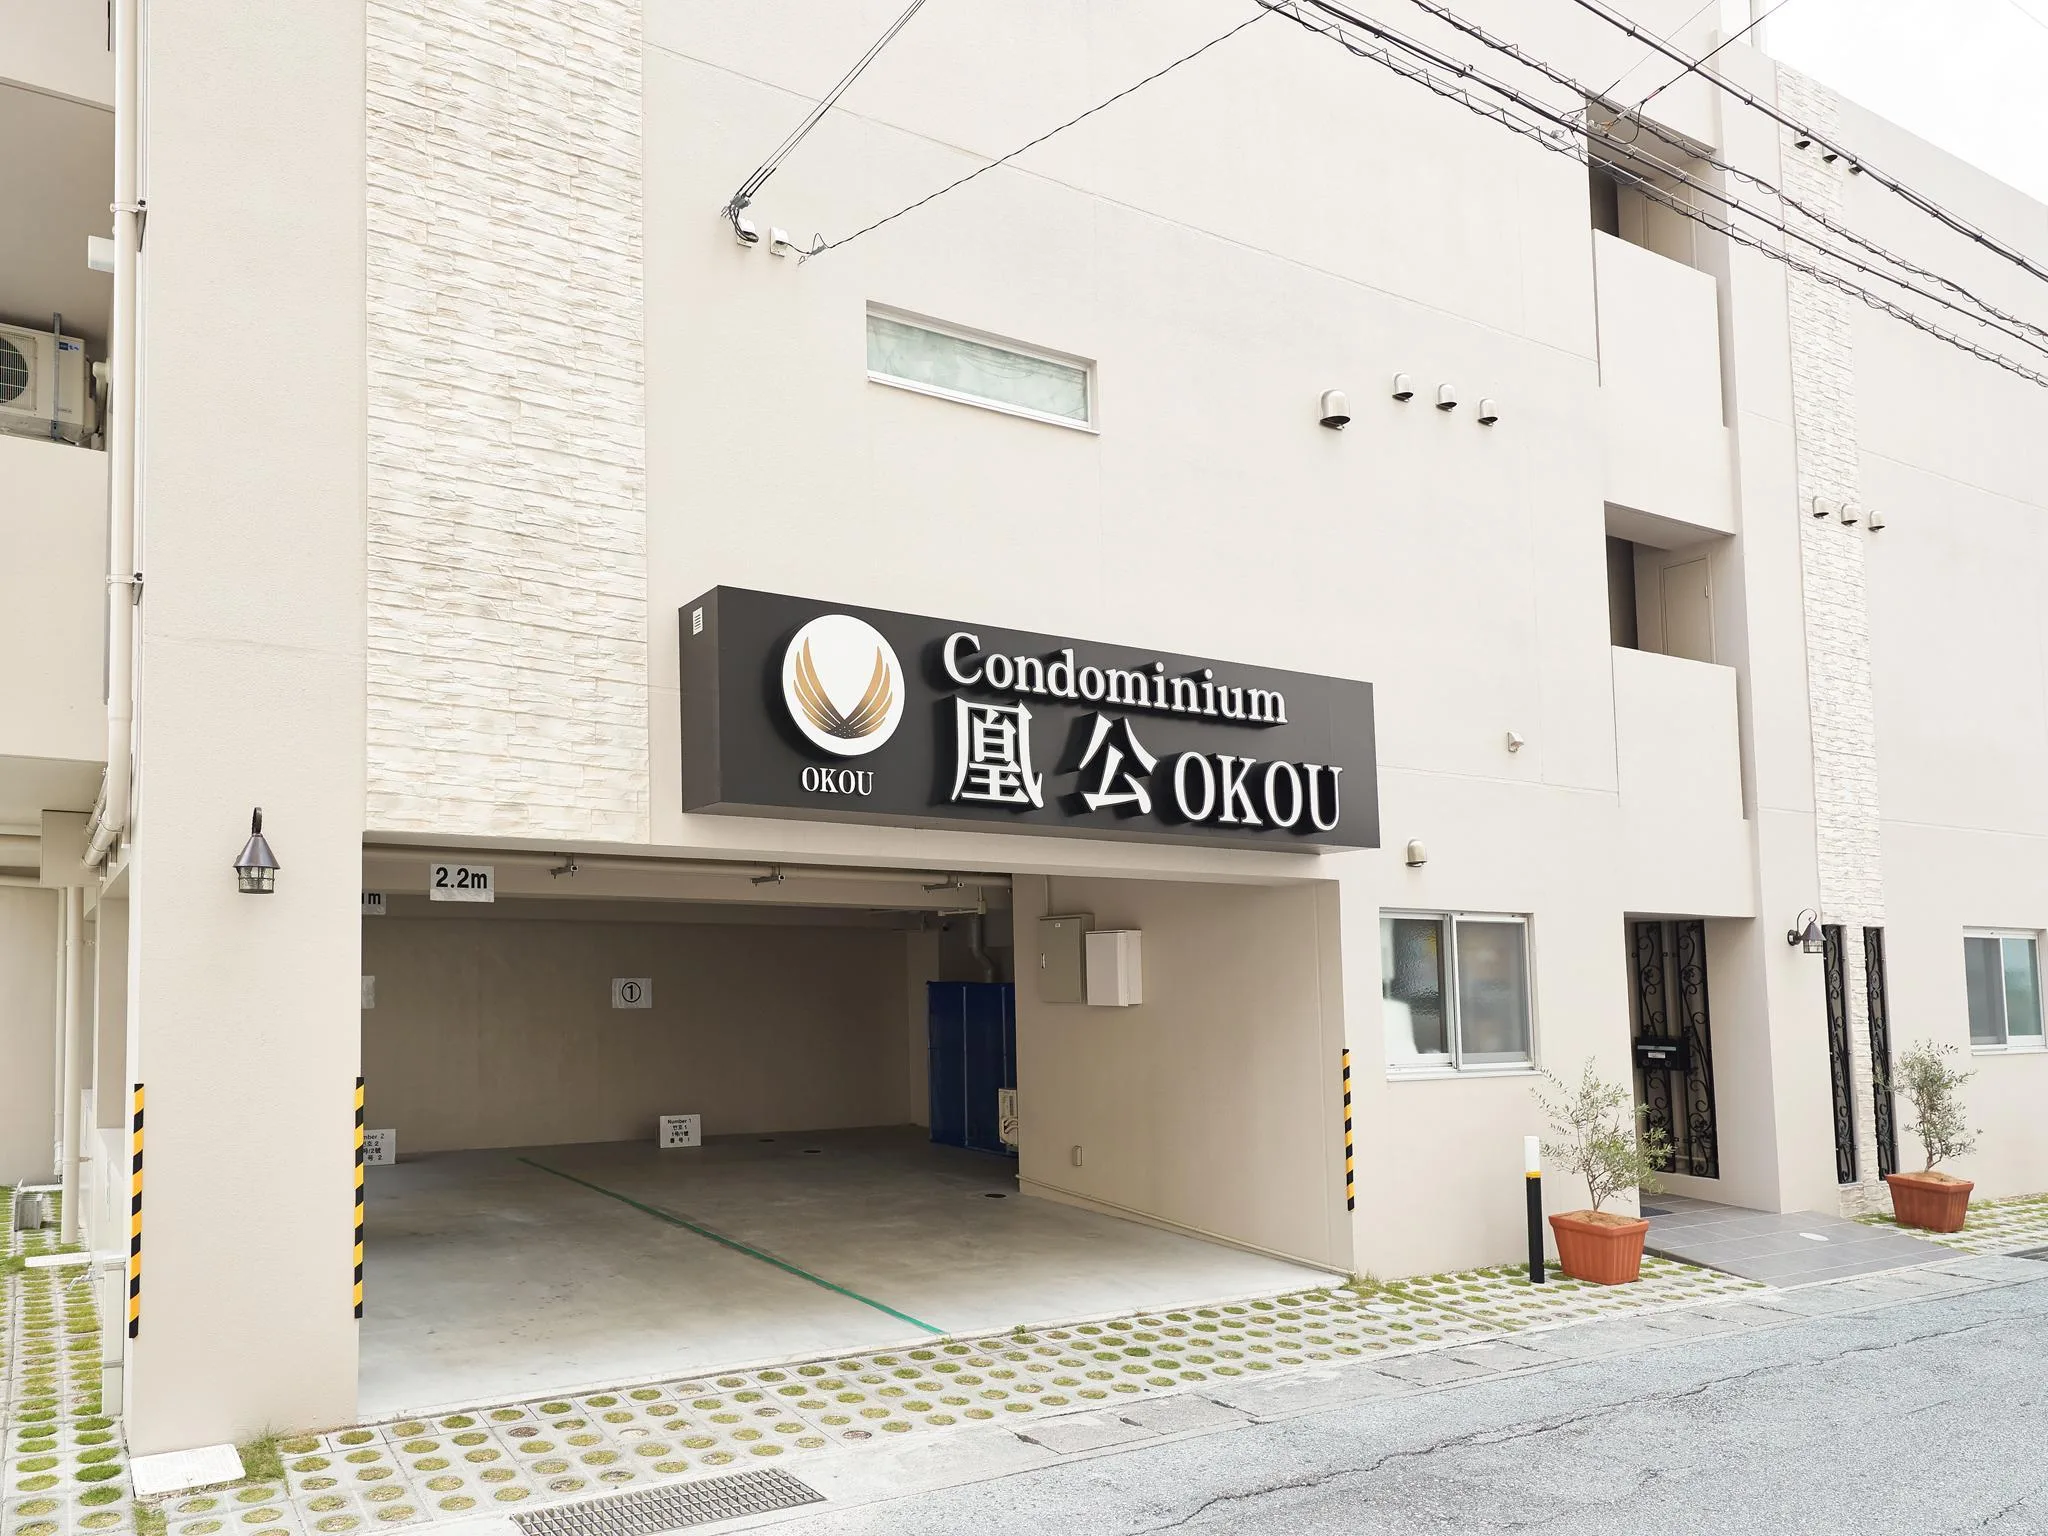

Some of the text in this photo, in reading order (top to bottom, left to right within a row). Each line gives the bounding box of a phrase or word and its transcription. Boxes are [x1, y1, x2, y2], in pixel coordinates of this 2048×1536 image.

[942, 631, 1289, 724] Condominium
[801, 766, 875, 796] OKOU
[1173, 750, 1344, 831] OKOU
[435, 866, 488, 889] 2.2m
